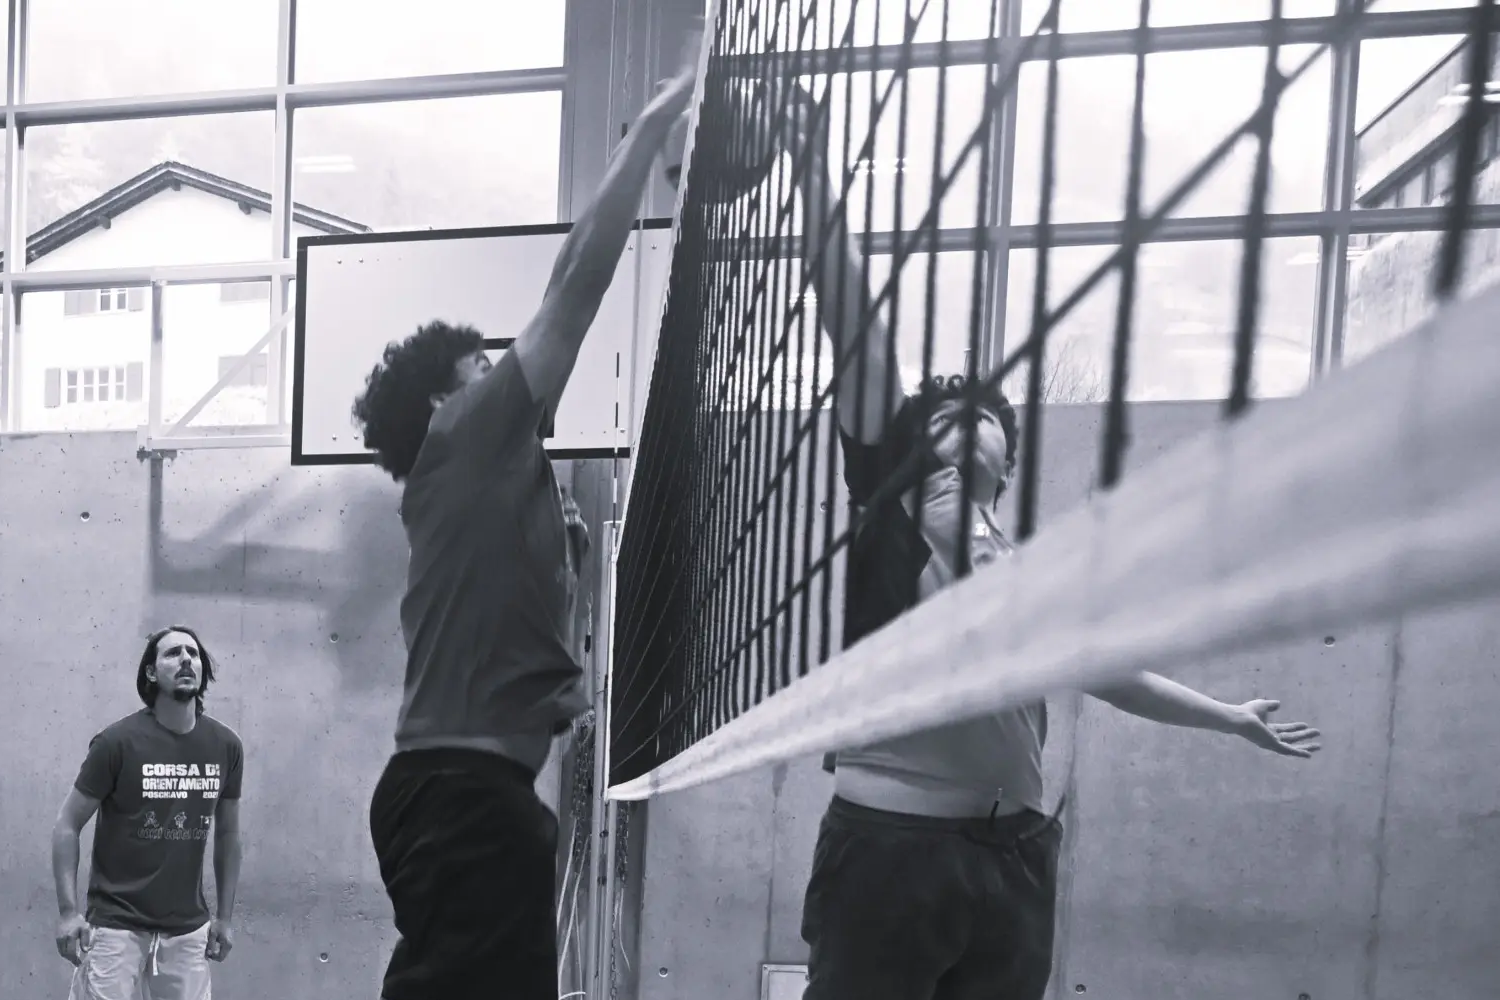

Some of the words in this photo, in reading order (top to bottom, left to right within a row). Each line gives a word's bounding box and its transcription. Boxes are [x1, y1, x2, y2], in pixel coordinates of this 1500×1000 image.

[142, 763, 201, 777] CORSA
[204, 763, 220, 777] DI
[142, 777, 220, 790] ORIENTAMENTO
[142, 791, 188, 799] POSCHIAVO
